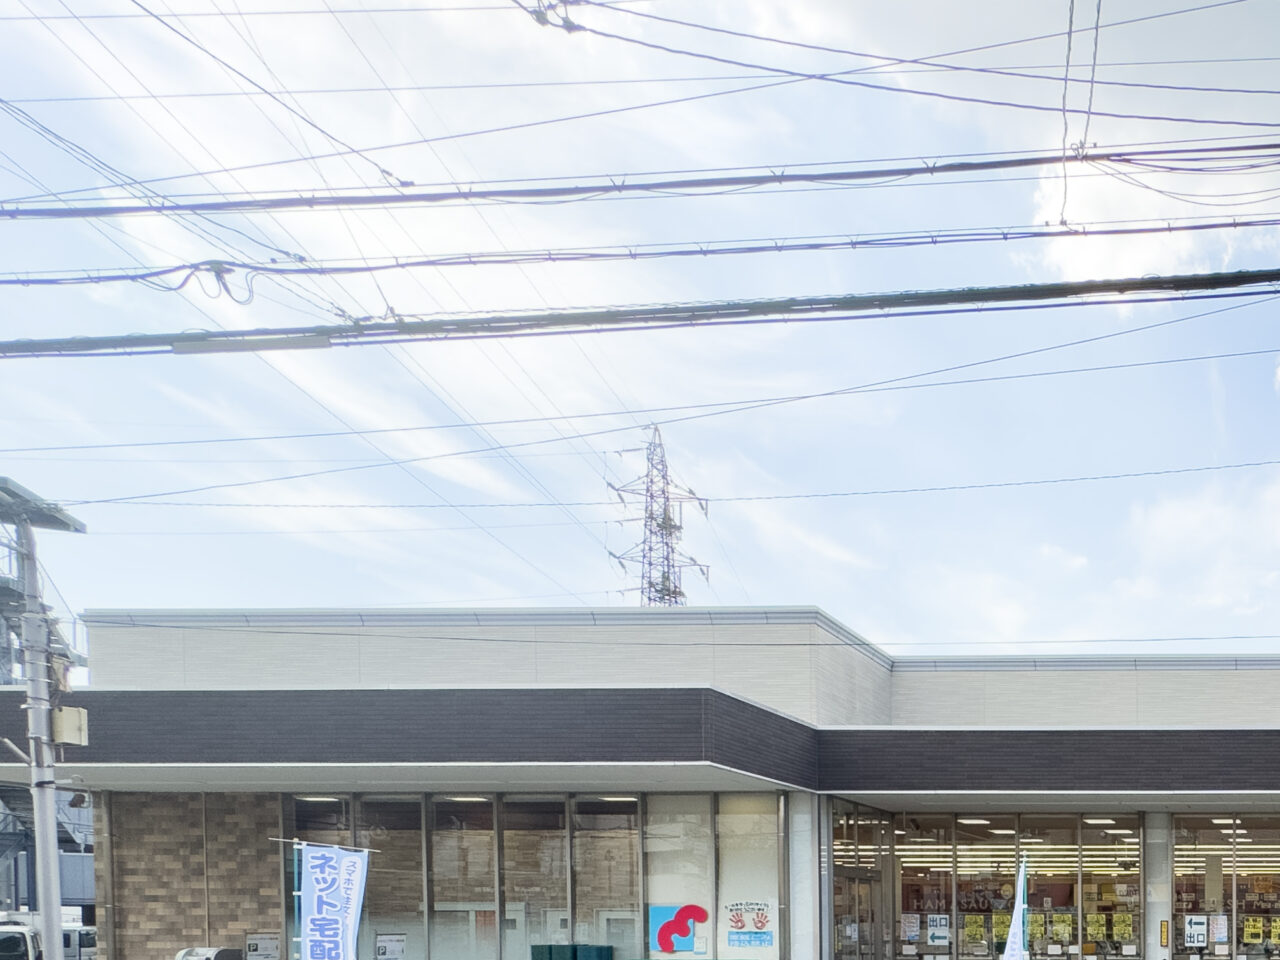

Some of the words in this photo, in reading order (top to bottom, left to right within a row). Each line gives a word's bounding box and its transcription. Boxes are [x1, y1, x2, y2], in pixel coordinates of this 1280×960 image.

[309, 853, 341, 960] ネット宅配
[928, 917, 948, 928] 出口
[1186, 932, 1206, 944] 出口
